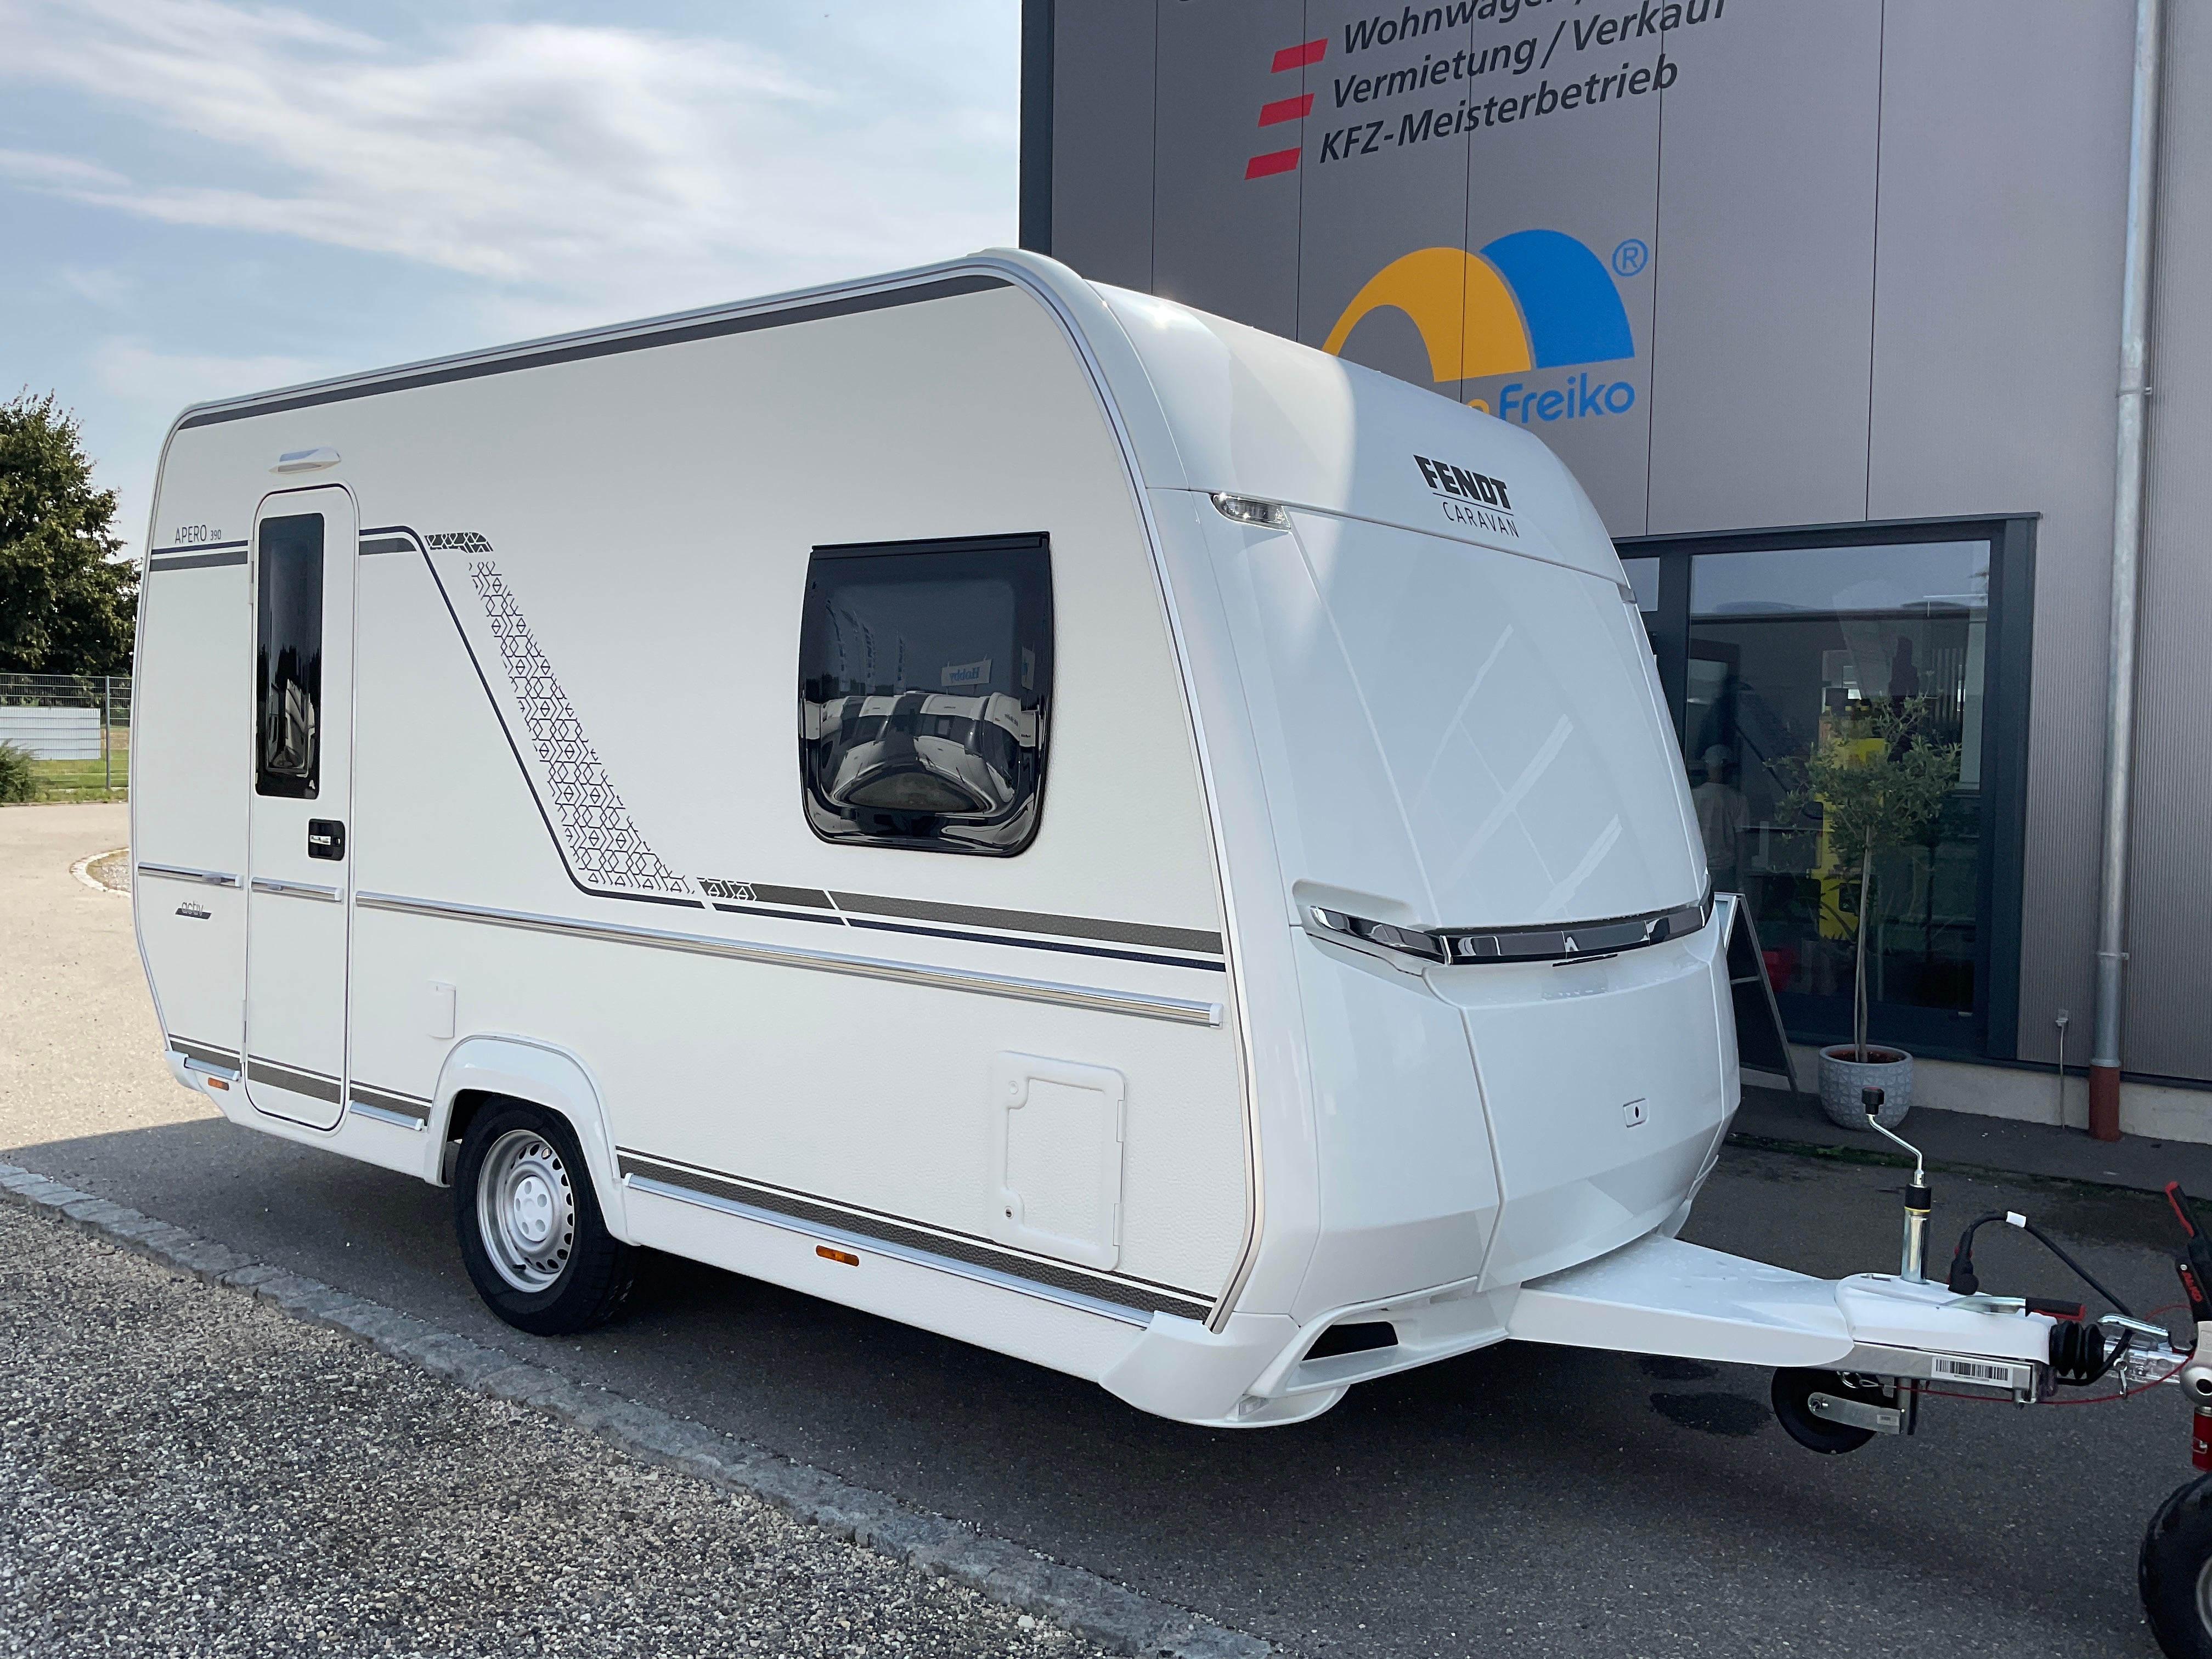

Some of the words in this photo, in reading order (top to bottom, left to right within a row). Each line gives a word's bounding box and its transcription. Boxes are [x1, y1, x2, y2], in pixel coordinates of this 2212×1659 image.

[1345, 0, 1552, 53] Wohnwag
[1319, 53, 1678, 164] KFZ-Meisterbetrieb
[1499, 373, 1635, 424] Freiko
[1413, 454, 1511, 510] FENDT
[174, 524, 207, 544] APERO
[210, 529, 222, 541] 390
[1442, 501, 1519, 538] CARAVAN
